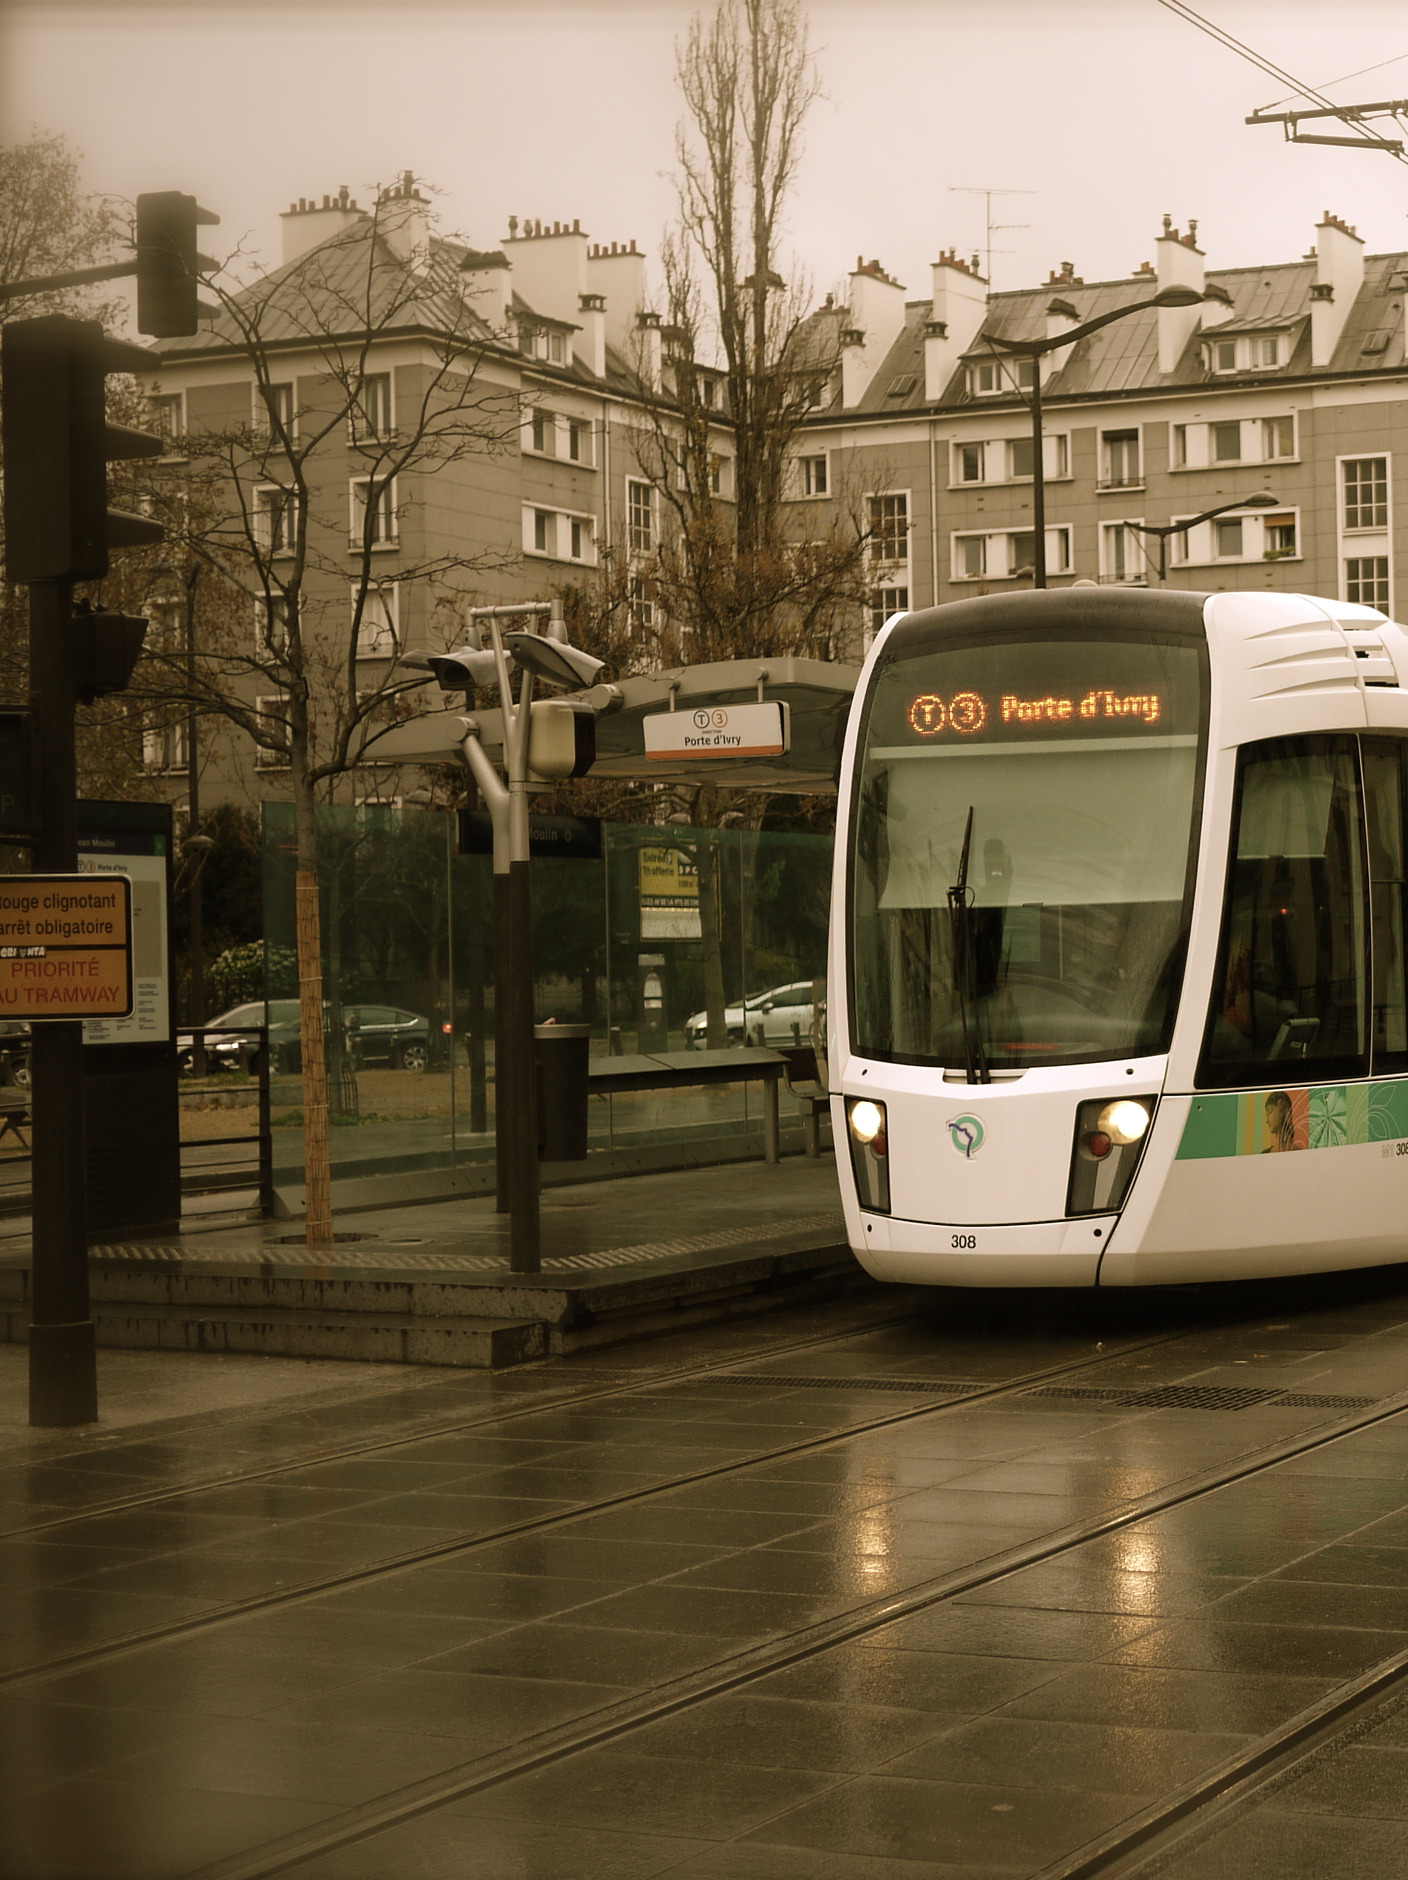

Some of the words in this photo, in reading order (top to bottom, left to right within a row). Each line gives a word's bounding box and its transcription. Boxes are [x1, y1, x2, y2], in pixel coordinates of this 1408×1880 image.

[1000, 694, 1073, 722] Porte
[1079, 690, 1160, 723] d'Ivry
[684, 736, 711, 746] Porte
[713, 734, 742, 746] d'Ivry
[91, 838, 116, 848] Moulin
[0, 895, 39, 912] ouge
[43, 893, 116, 912] clignotant
[35, 918, 113, 938] obligatoire
[11, 957, 100, 978] PRIORITÉ
[23, 986, 120, 1004] TRAMWAY
[951, 1234, 976, 1250] 308
